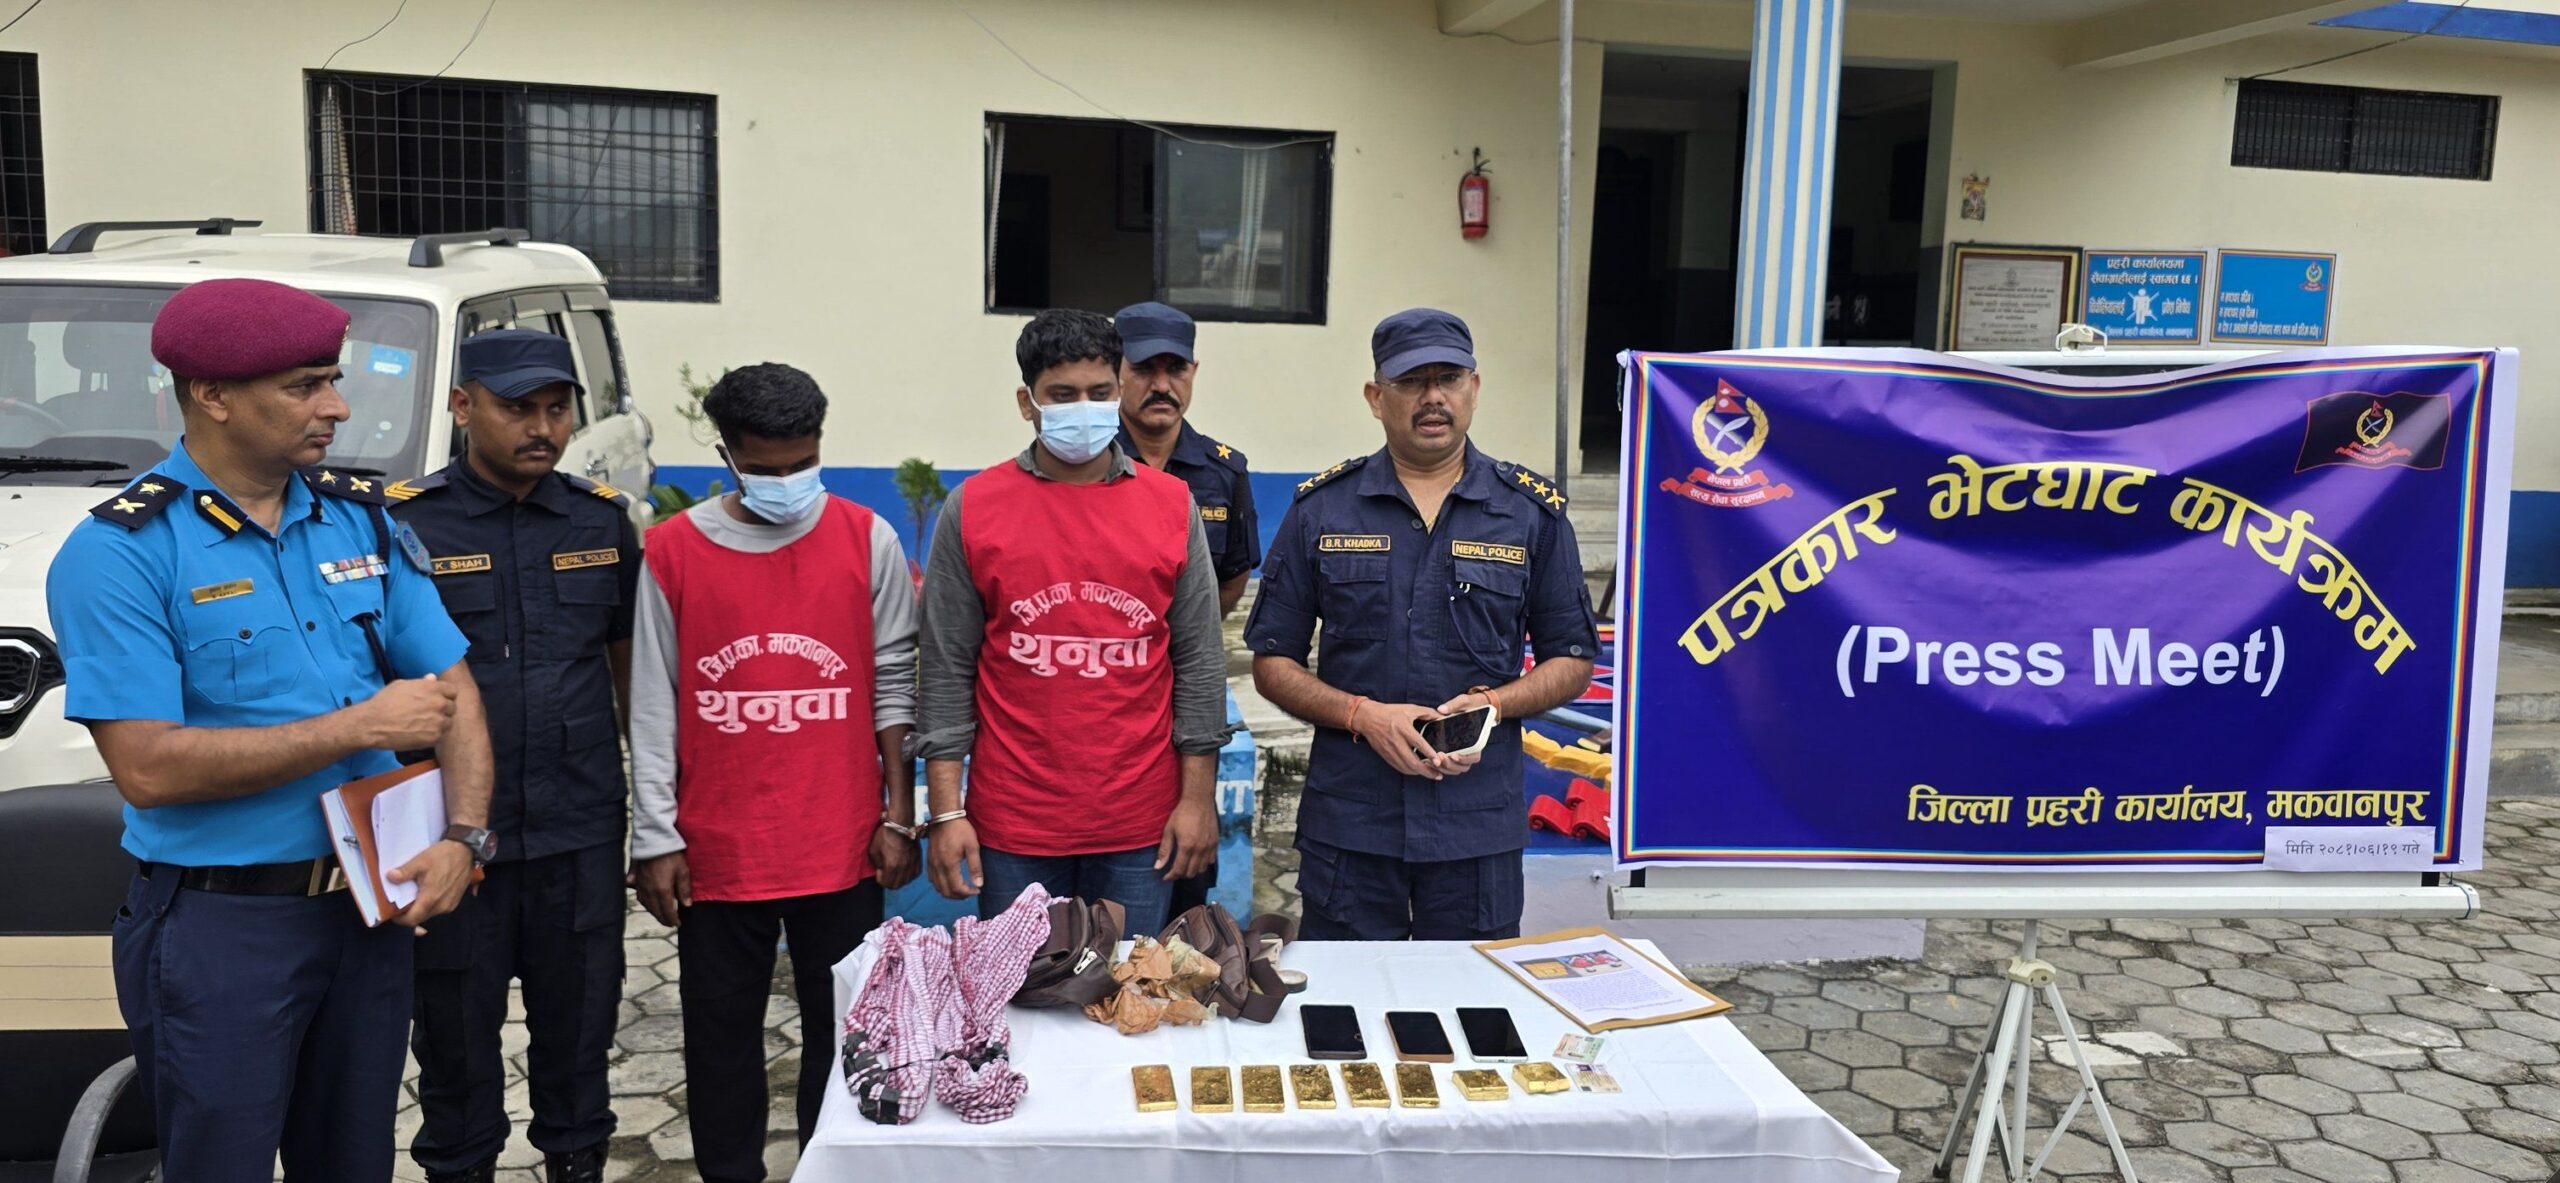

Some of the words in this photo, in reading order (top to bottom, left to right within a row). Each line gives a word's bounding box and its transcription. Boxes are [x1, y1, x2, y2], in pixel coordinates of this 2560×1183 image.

[1707, 474, 1731, 486] नेपाल
[1733, 474, 1751, 487] प्रहरी
[1711, 493, 1728, 505] सेवा
[1344, 538, 1382, 548] KHADKA
[1455, 543, 1487, 556] NEPAL
[1488, 547, 1522, 560] POLICE
[450, 558, 483, 570] SHAH
[557, 555, 584, 566] NEPAL
[585, 552, 615, 563] POLICE
[1677, 487, 1897, 666] पत्रकार
[1927, 454, 2157, 519] भेटघाट
[2169, 477, 2417, 675] कार्यक्रम
[1010, 582, 1077, 627] जि.प्र.का.
[1080, 581, 1157, 631] मकवानपुर
[696, 634, 764, 682] जि.प्र.का.
[766, 633, 849, 680] मकवानपुर
[1008, 631, 1153, 678] थुनुवा
[1836, 625, 2065, 697] (Press
[2093, 626, 2286, 697] Meet)
[694, 687, 852, 734] थुनुवा
[1908, 784, 2012, 822] जिल्ला
[2026, 787, 2104, 827] प्रहरी
[2115, 785, 2253, 825] कार्यालय,
[2266, 789, 2430, 827] मकवानपुर
[2285, 839, 2315, 855] मिति
[2402, 840, 2421, 854] गते
